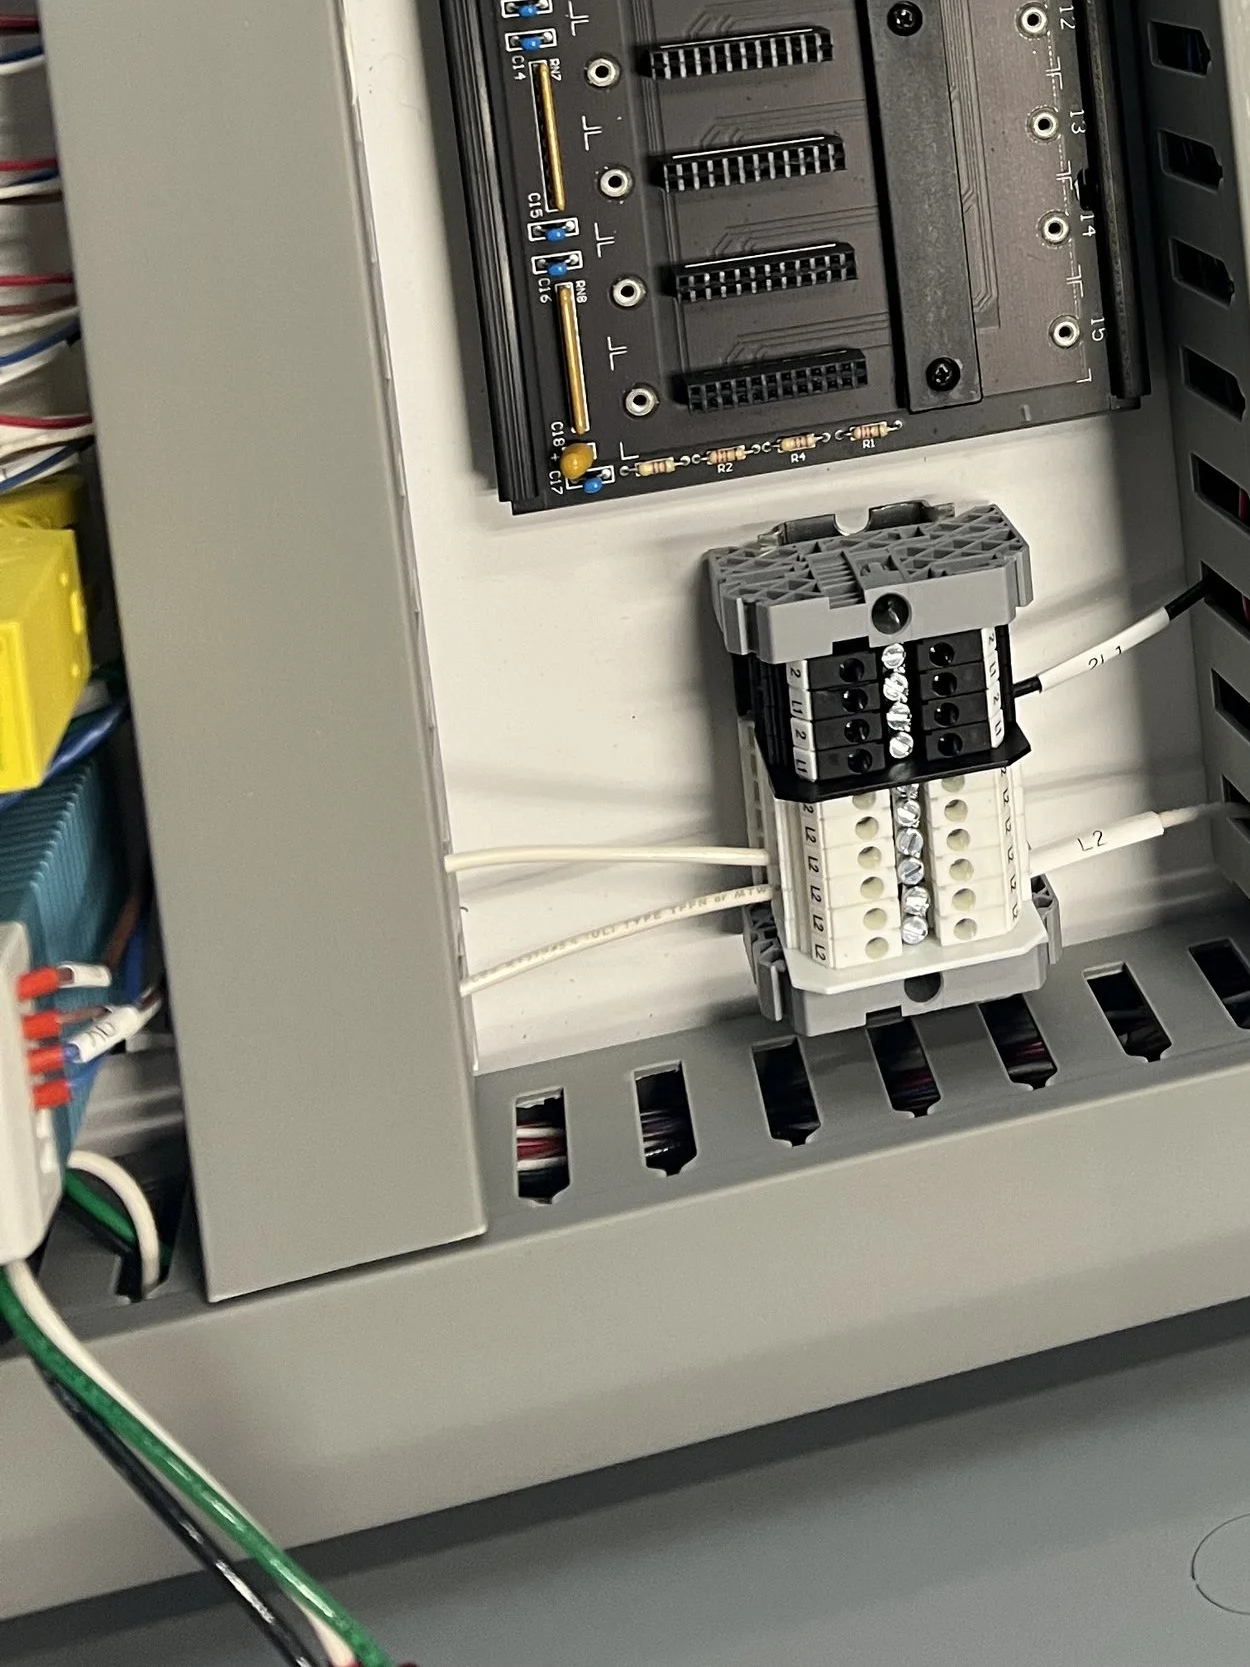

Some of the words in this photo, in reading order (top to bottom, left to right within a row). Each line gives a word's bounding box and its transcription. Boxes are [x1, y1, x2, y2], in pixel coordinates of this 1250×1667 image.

[1059, 5, 1076, 30] 12
[512, 55, 526, 82] C14
[549, 58, 562, 82] RN7
[1069, 108, 1086, 135] 13
[528, 192, 543, 219] C15
[1080, 213, 1096, 237] 14
[538, 277, 551, 304] C16
[575, 279, 588, 304] RN8
[1090, 316, 1106, 342] 15
[551, 421, 565, 447] C18
[861, 438, 876, 449] R1
[790, 451, 806, 464] R4
[717, 462, 733, 474] R2
[549, 470, 563, 495] C17
[790, 667, 801, 678] 2
[791, 700, 803, 714] L1
[795, 728, 806, 740] 2
[796, 759, 808, 774] L1
[805, 826, 817, 844] L2
[1077, 830, 1108, 851] L2
[808, 855, 819, 873] L2
[810, 885, 822, 903] L2
[813, 914, 824, 932] L2
[814, 944, 826, 961] L2
